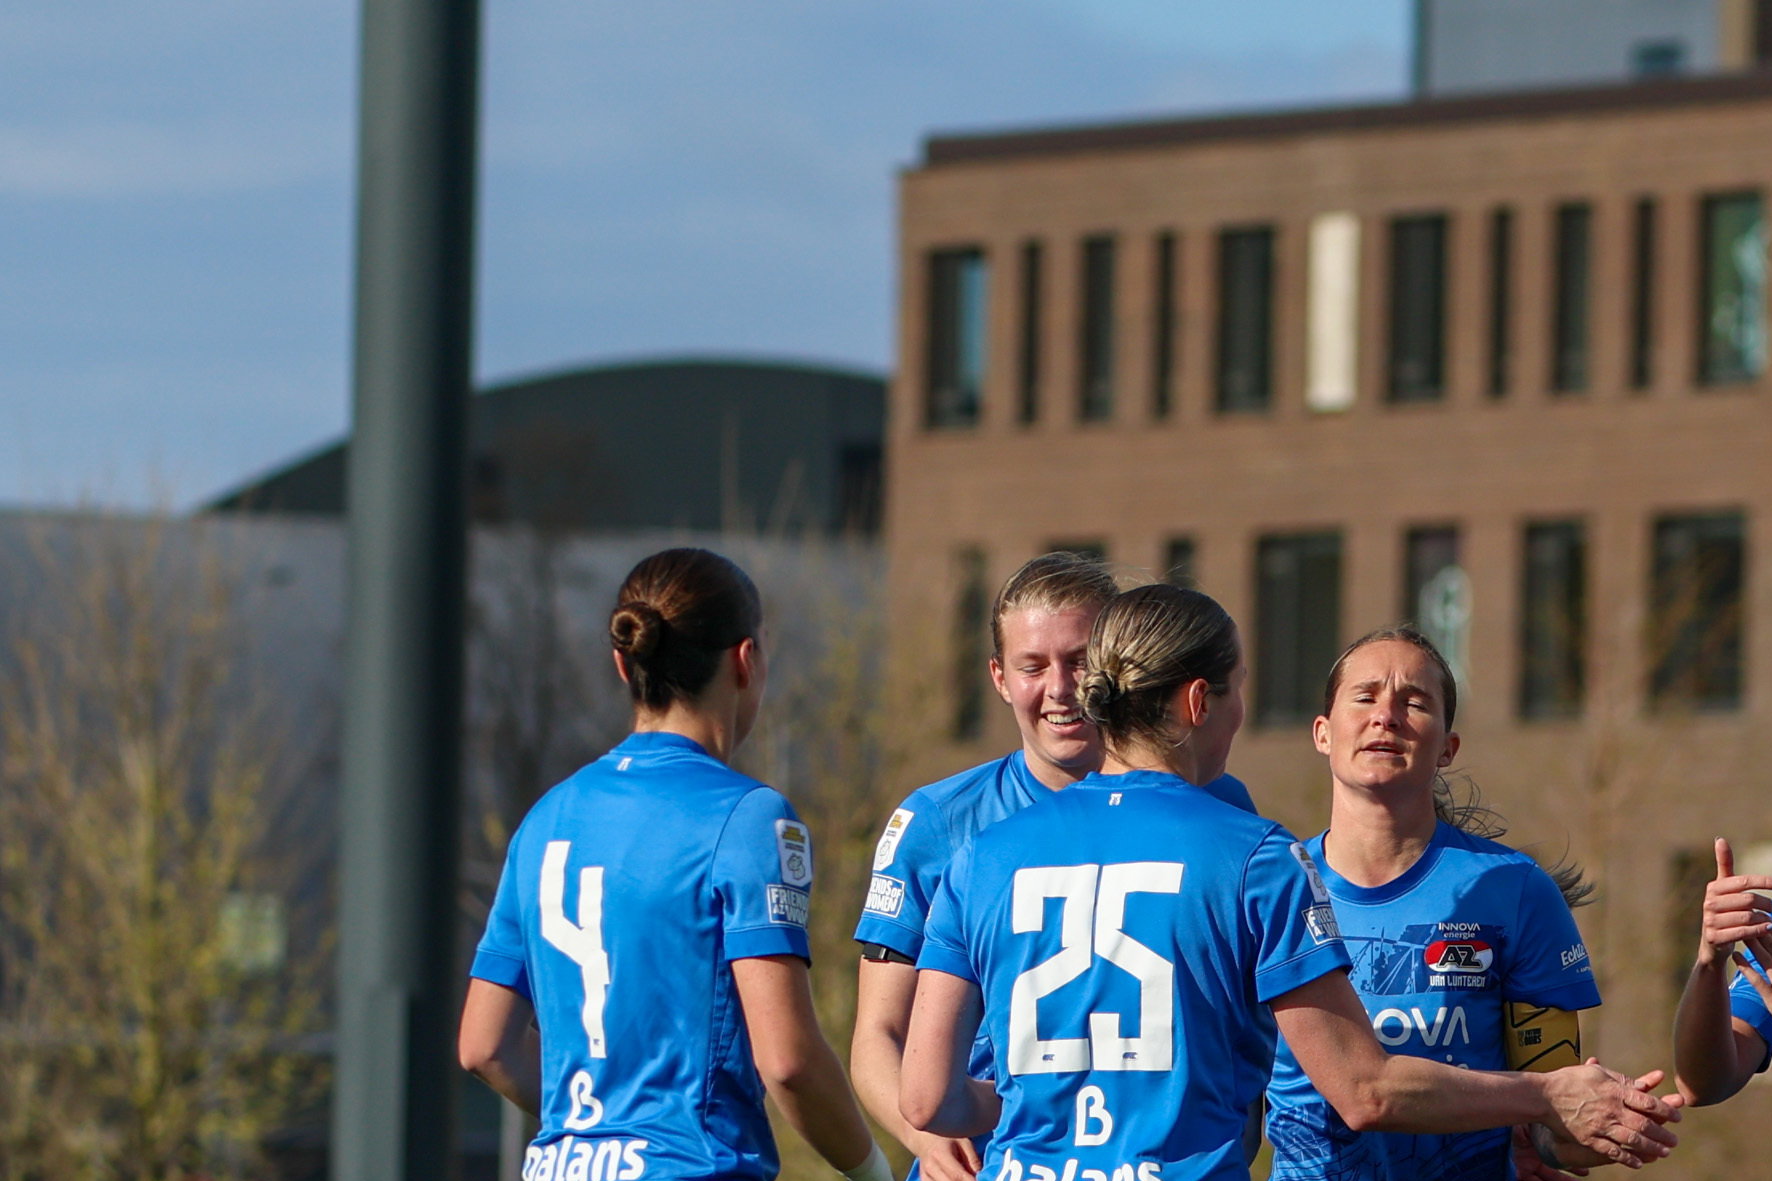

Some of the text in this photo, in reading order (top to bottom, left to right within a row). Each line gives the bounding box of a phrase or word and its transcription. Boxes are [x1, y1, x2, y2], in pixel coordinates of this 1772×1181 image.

[540, 841, 610, 1059] 4
[1008, 861, 1184, 1076] 25
[1437, 944, 1483, 968] AZ
[1438, 922, 1480, 931] INNOVA
